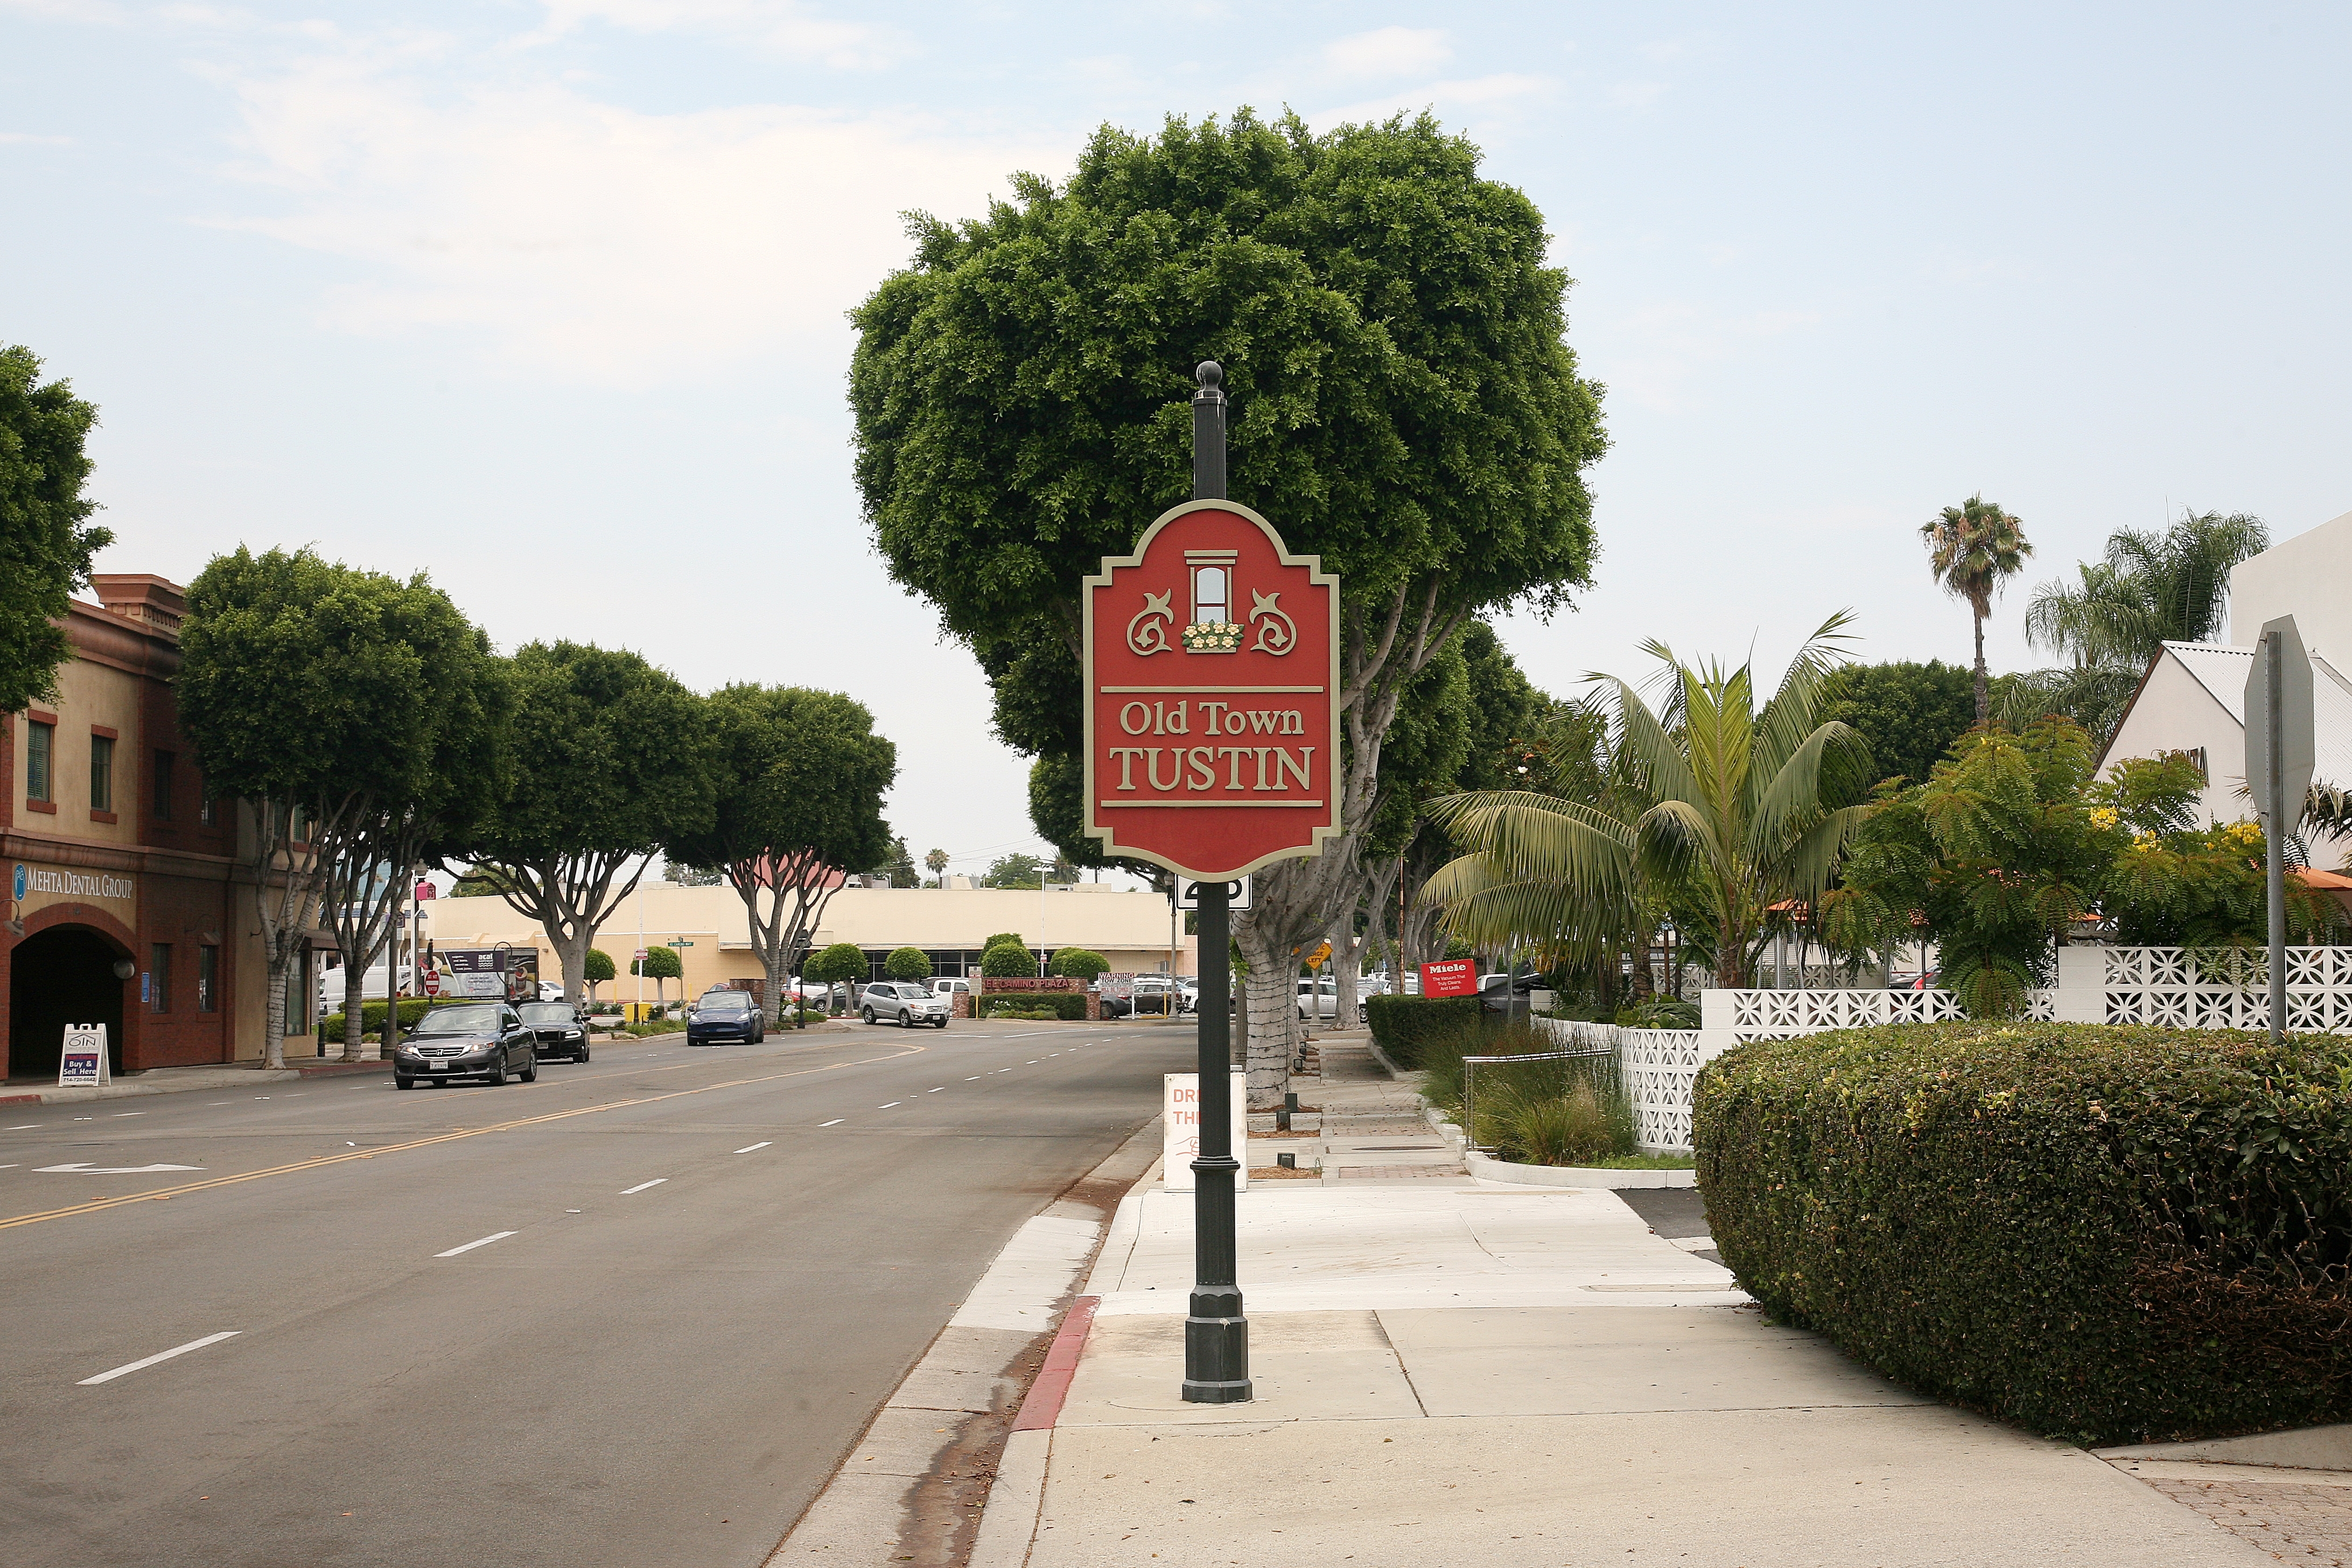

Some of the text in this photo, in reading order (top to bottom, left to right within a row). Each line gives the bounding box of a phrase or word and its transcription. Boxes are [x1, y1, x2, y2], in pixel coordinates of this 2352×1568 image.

[1120, 700, 1305, 736] Old Town
[1109, 746, 1315, 791] TUSTIN
[27, 866, 132, 899] MEHTA DENTAL GROUP
[986, 979, 998, 988] EL
[1000, 979, 1036, 988] CAMINO
[1039, 979, 1069, 988] PLAZA
[1429, 964, 1466, 974] Miele
